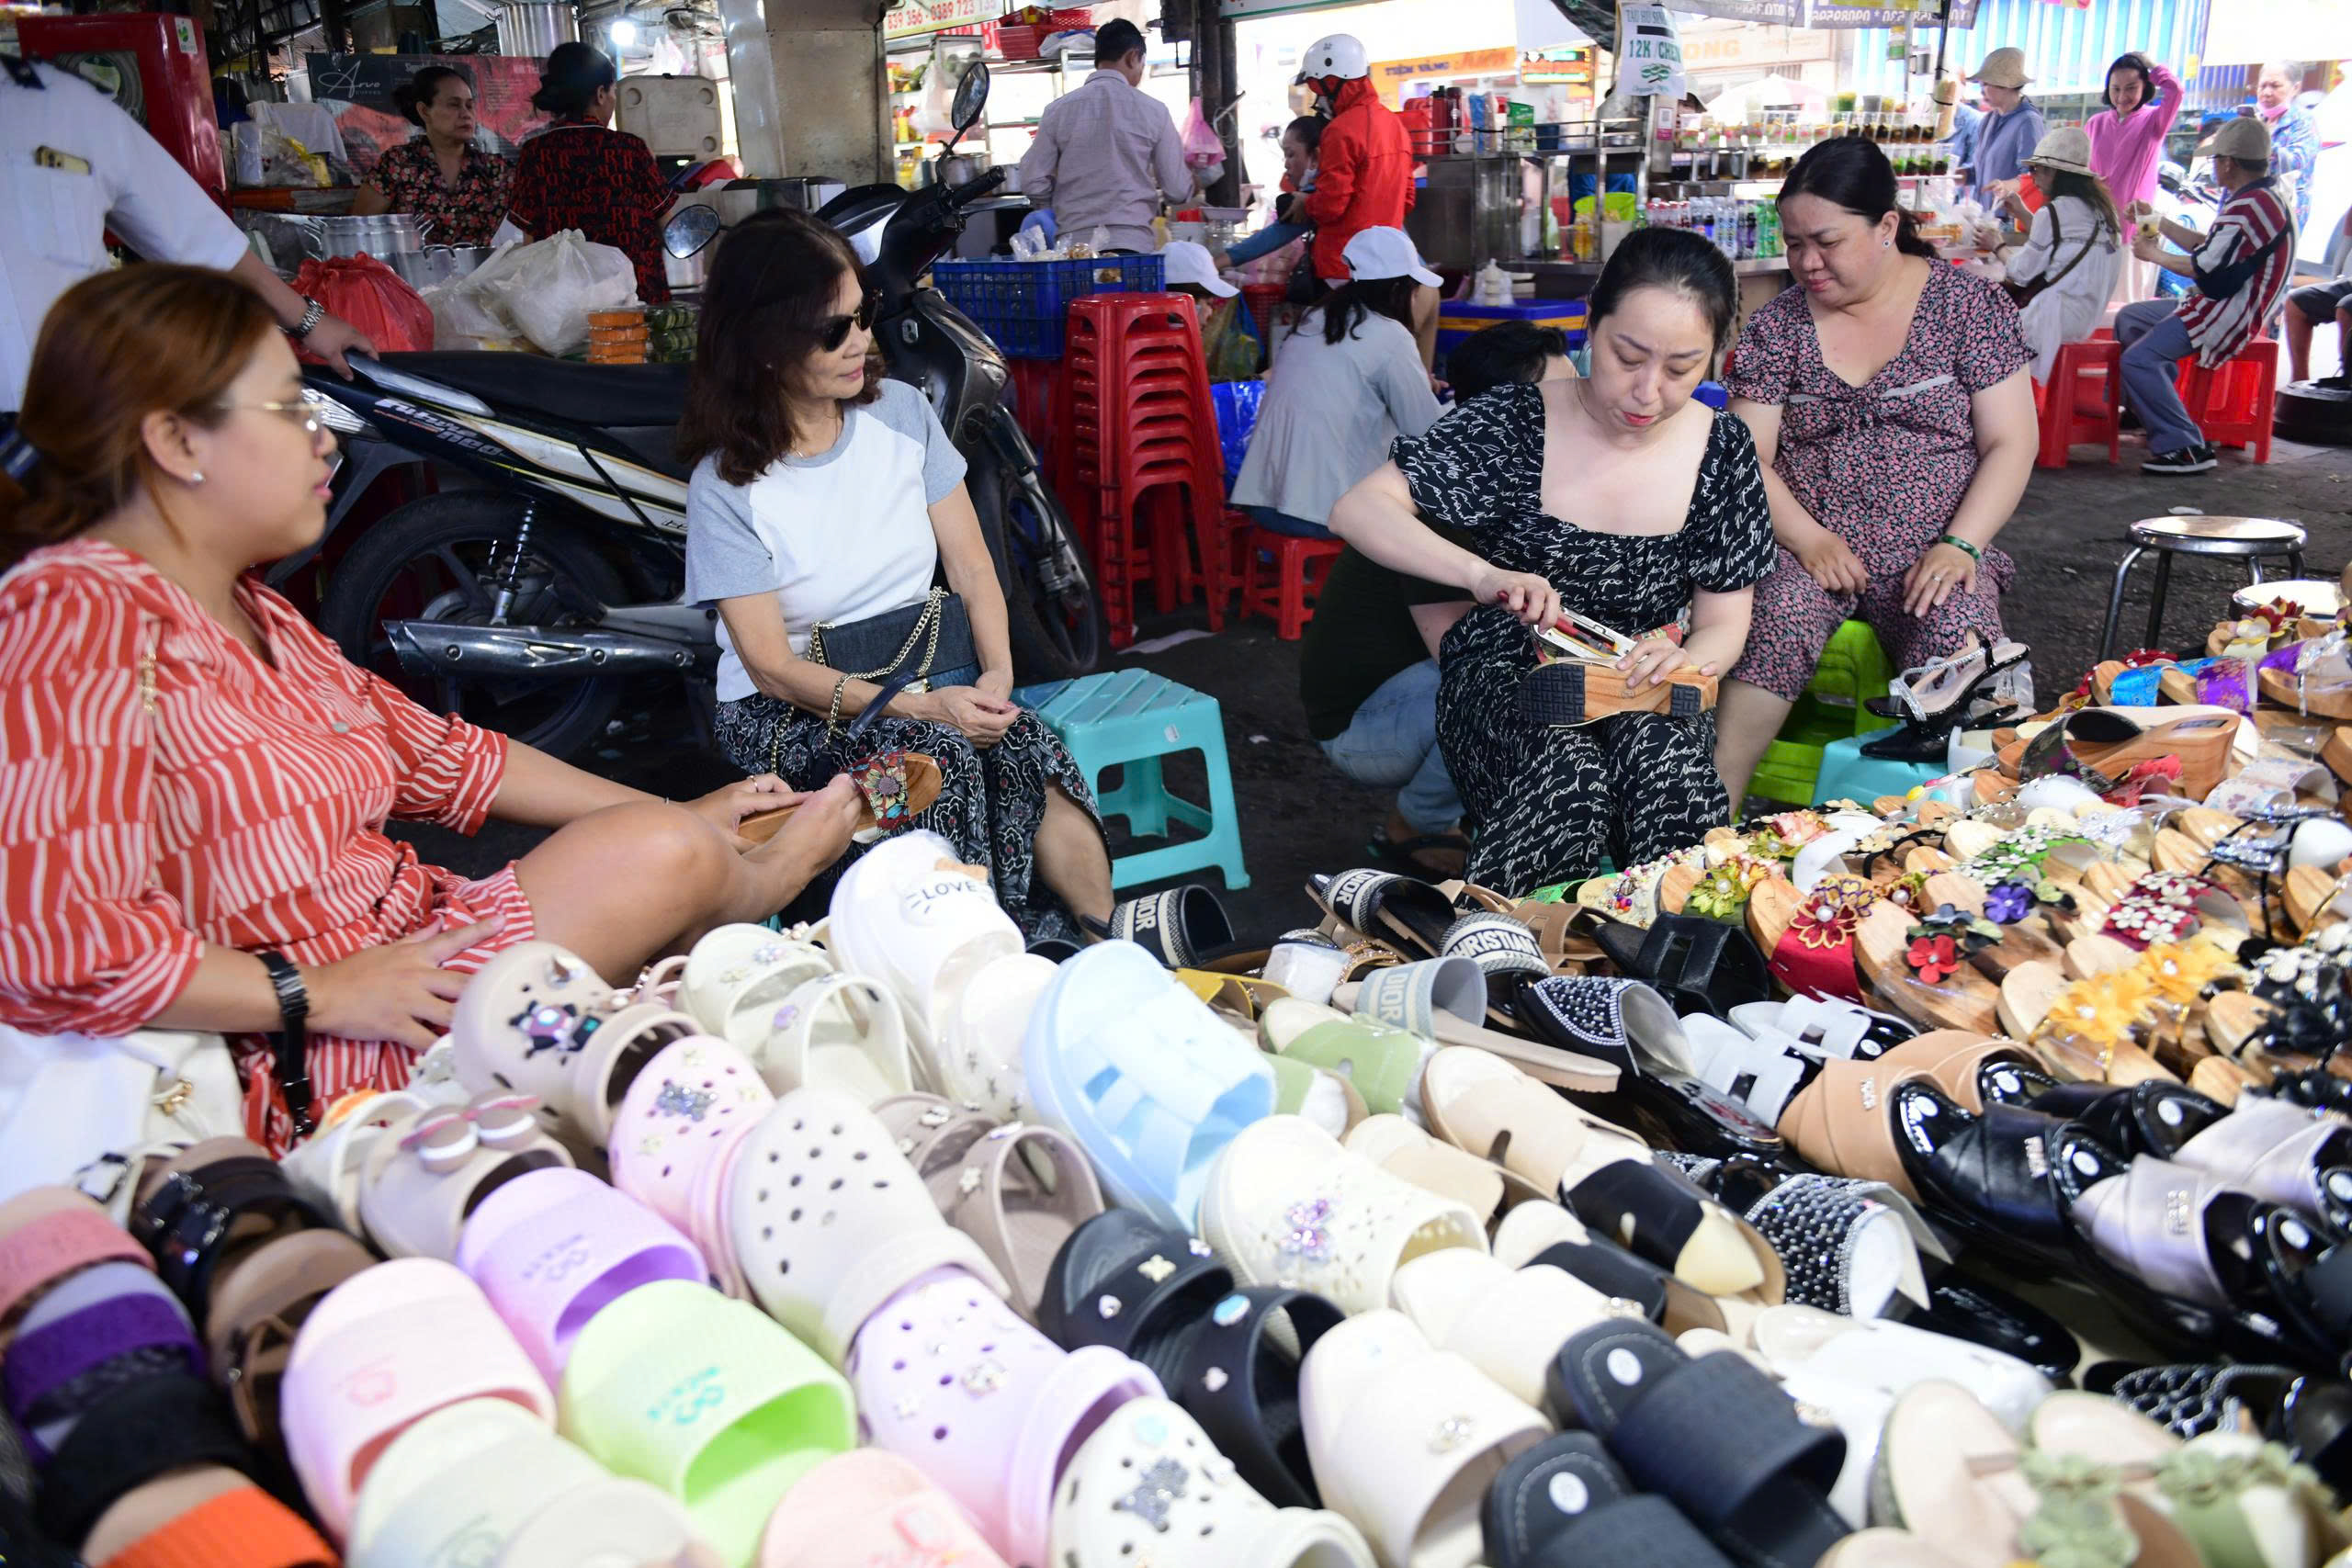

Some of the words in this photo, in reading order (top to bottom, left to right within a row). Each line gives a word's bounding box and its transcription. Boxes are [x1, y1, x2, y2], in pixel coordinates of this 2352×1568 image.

[1629, 39, 1651, 59] 12K
[318, 60, 381, 98] Arvo
[922, 880, 978, 900] LOVE
[1335, 873, 1375, 906] DIOR
[1135, 892, 1160, 933] DIOR
[1381, 973, 1408, 1021] DIOR
